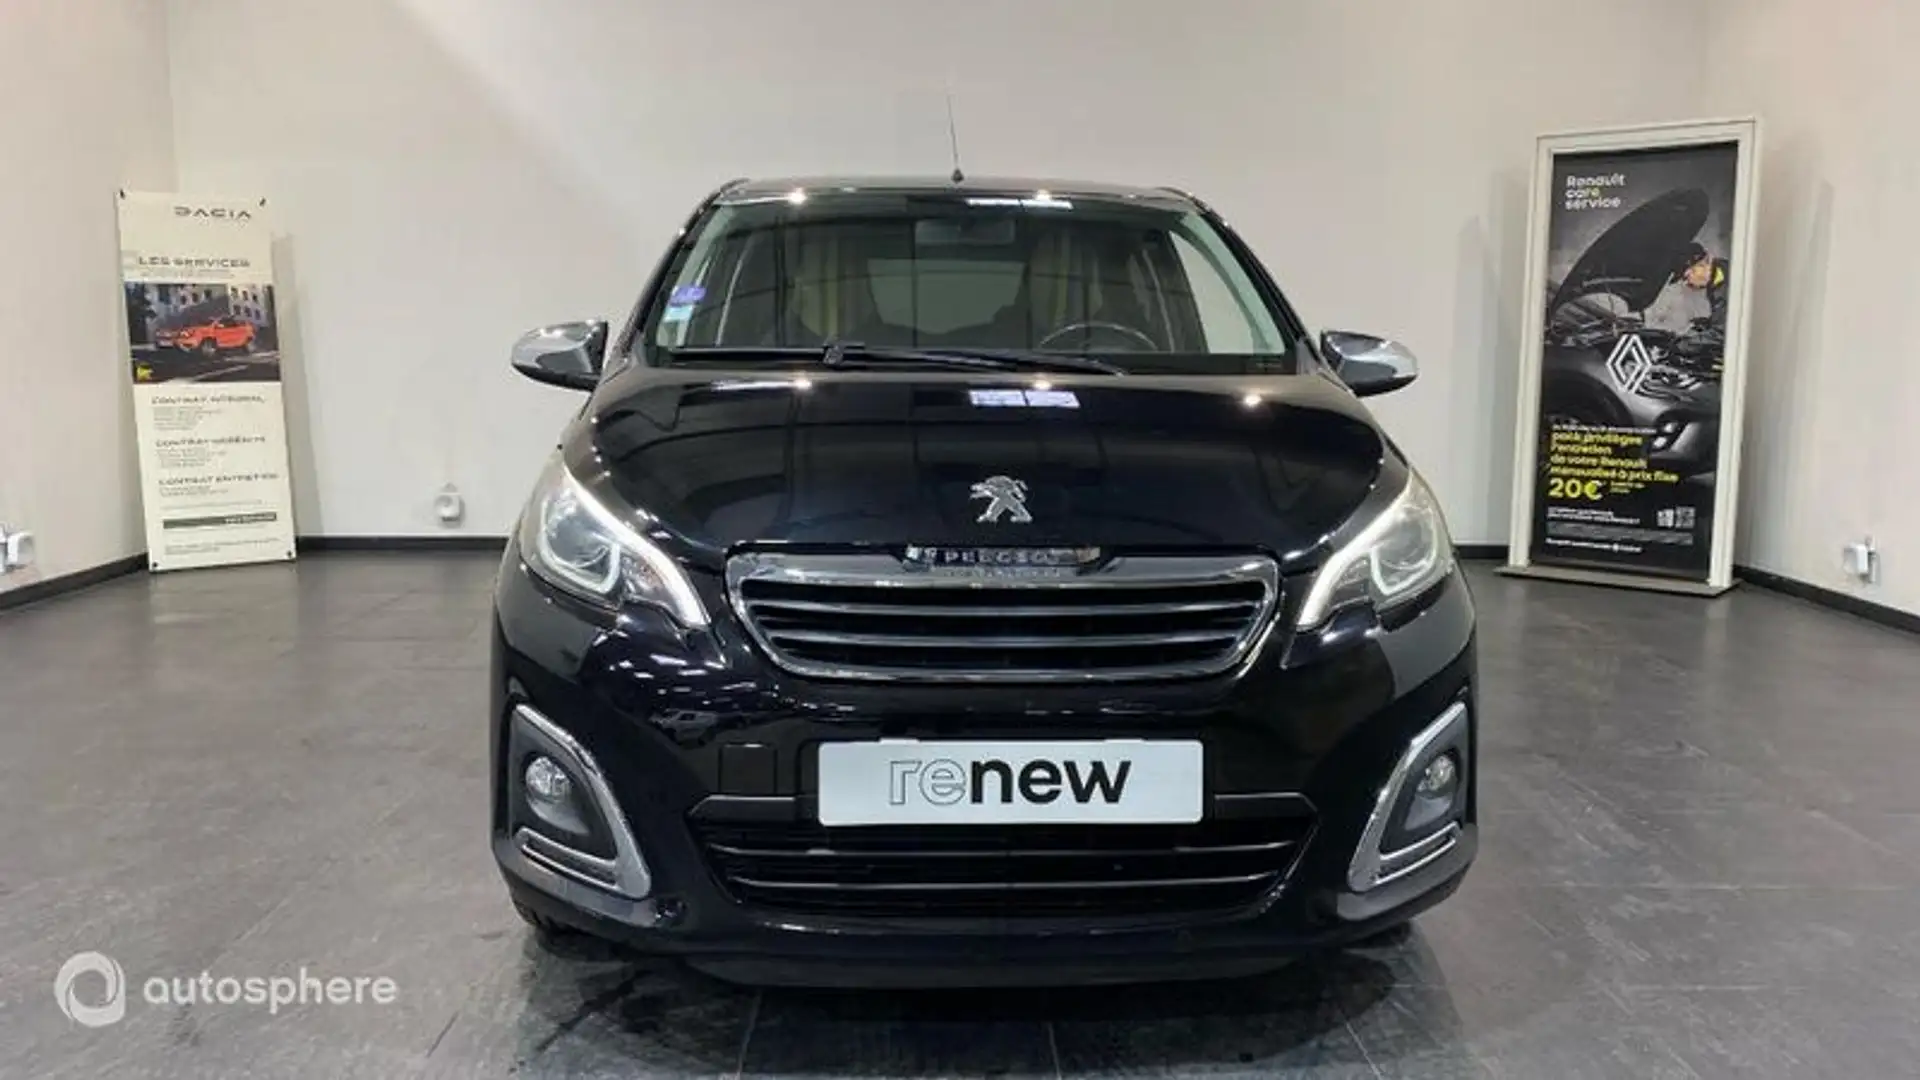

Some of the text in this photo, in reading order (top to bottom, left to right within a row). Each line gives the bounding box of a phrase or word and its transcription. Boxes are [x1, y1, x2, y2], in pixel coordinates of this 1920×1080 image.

[1566, 173, 1626, 187] Renault
[1565, 188, 1600, 198] care
[1565, 197, 1621, 210] service
[174, 206, 251, 218] DACIA
[138, 256, 170, 266] LES
[944, 548, 1062, 564] PEUGEO
[888, 758, 1132, 806] renew
